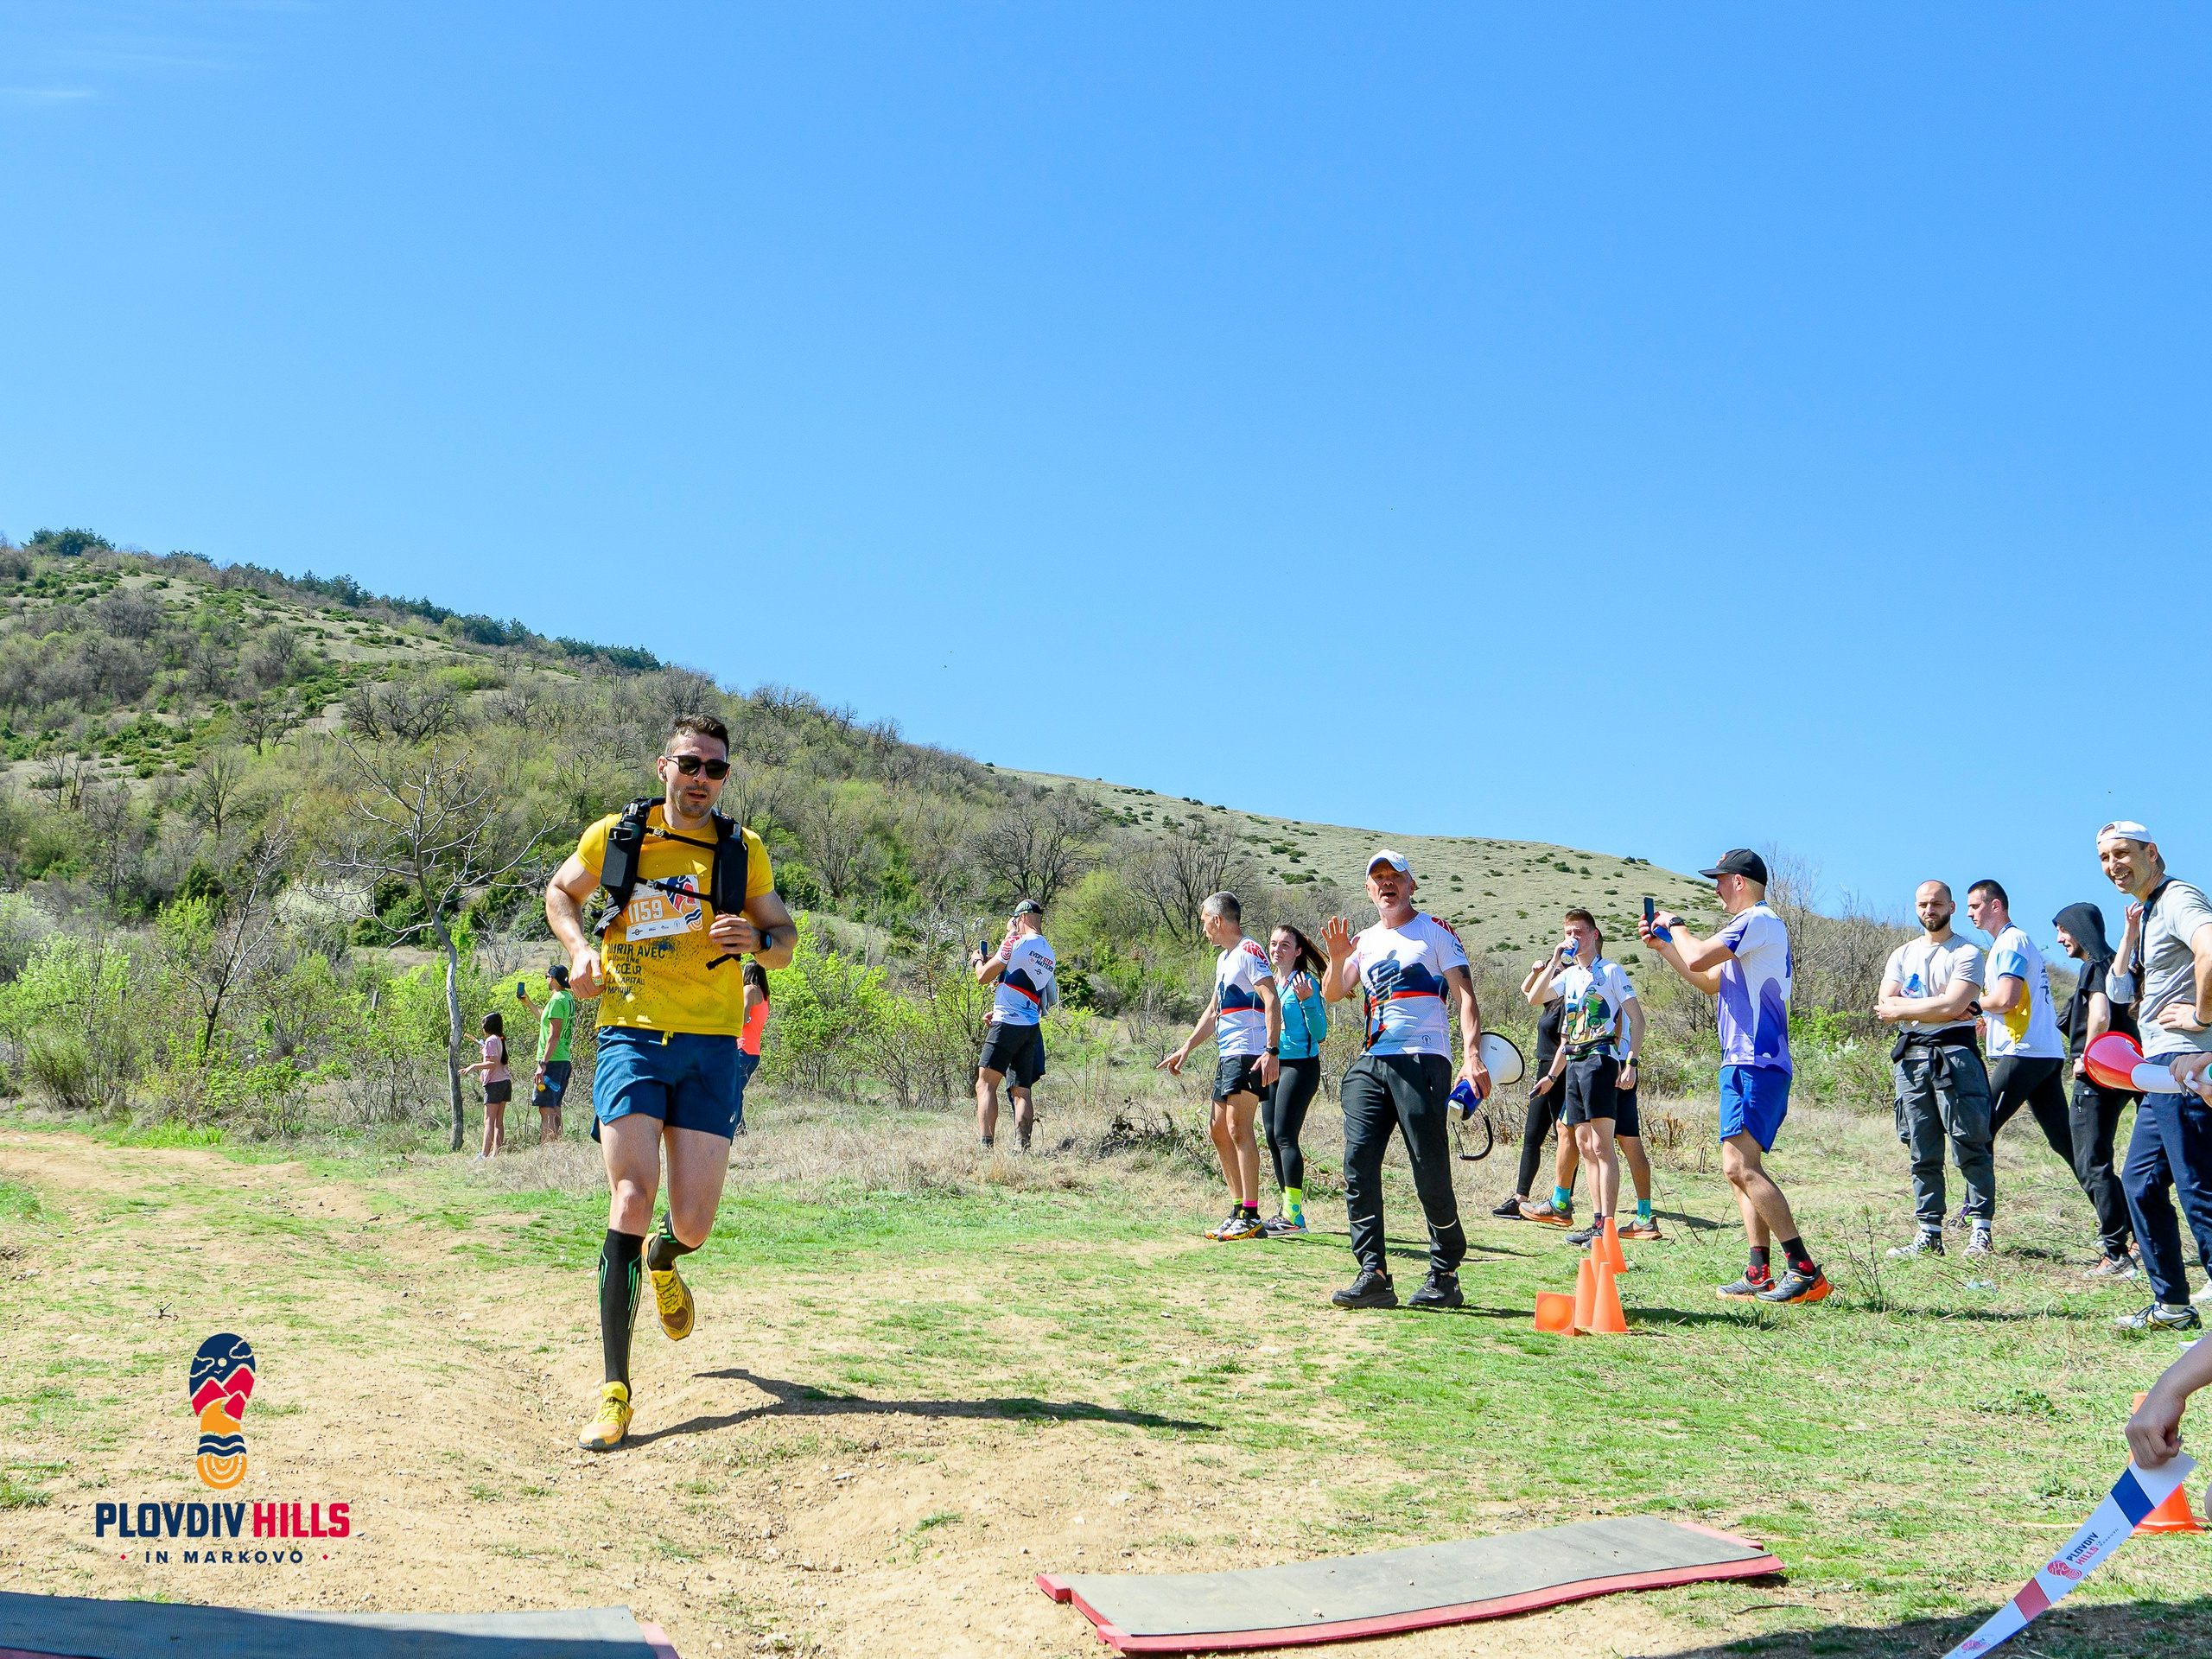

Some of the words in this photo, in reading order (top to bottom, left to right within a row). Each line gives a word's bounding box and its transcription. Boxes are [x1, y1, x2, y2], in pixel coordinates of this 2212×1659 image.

[628, 899, 664, 924] 1159
[637, 944, 666, 959] AVEC
[1043, 957, 1053, 966] STEP
[2066, 1532, 2098, 1561] PLOVDIV
[2075, 1546, 2099, 1565] HILLS
